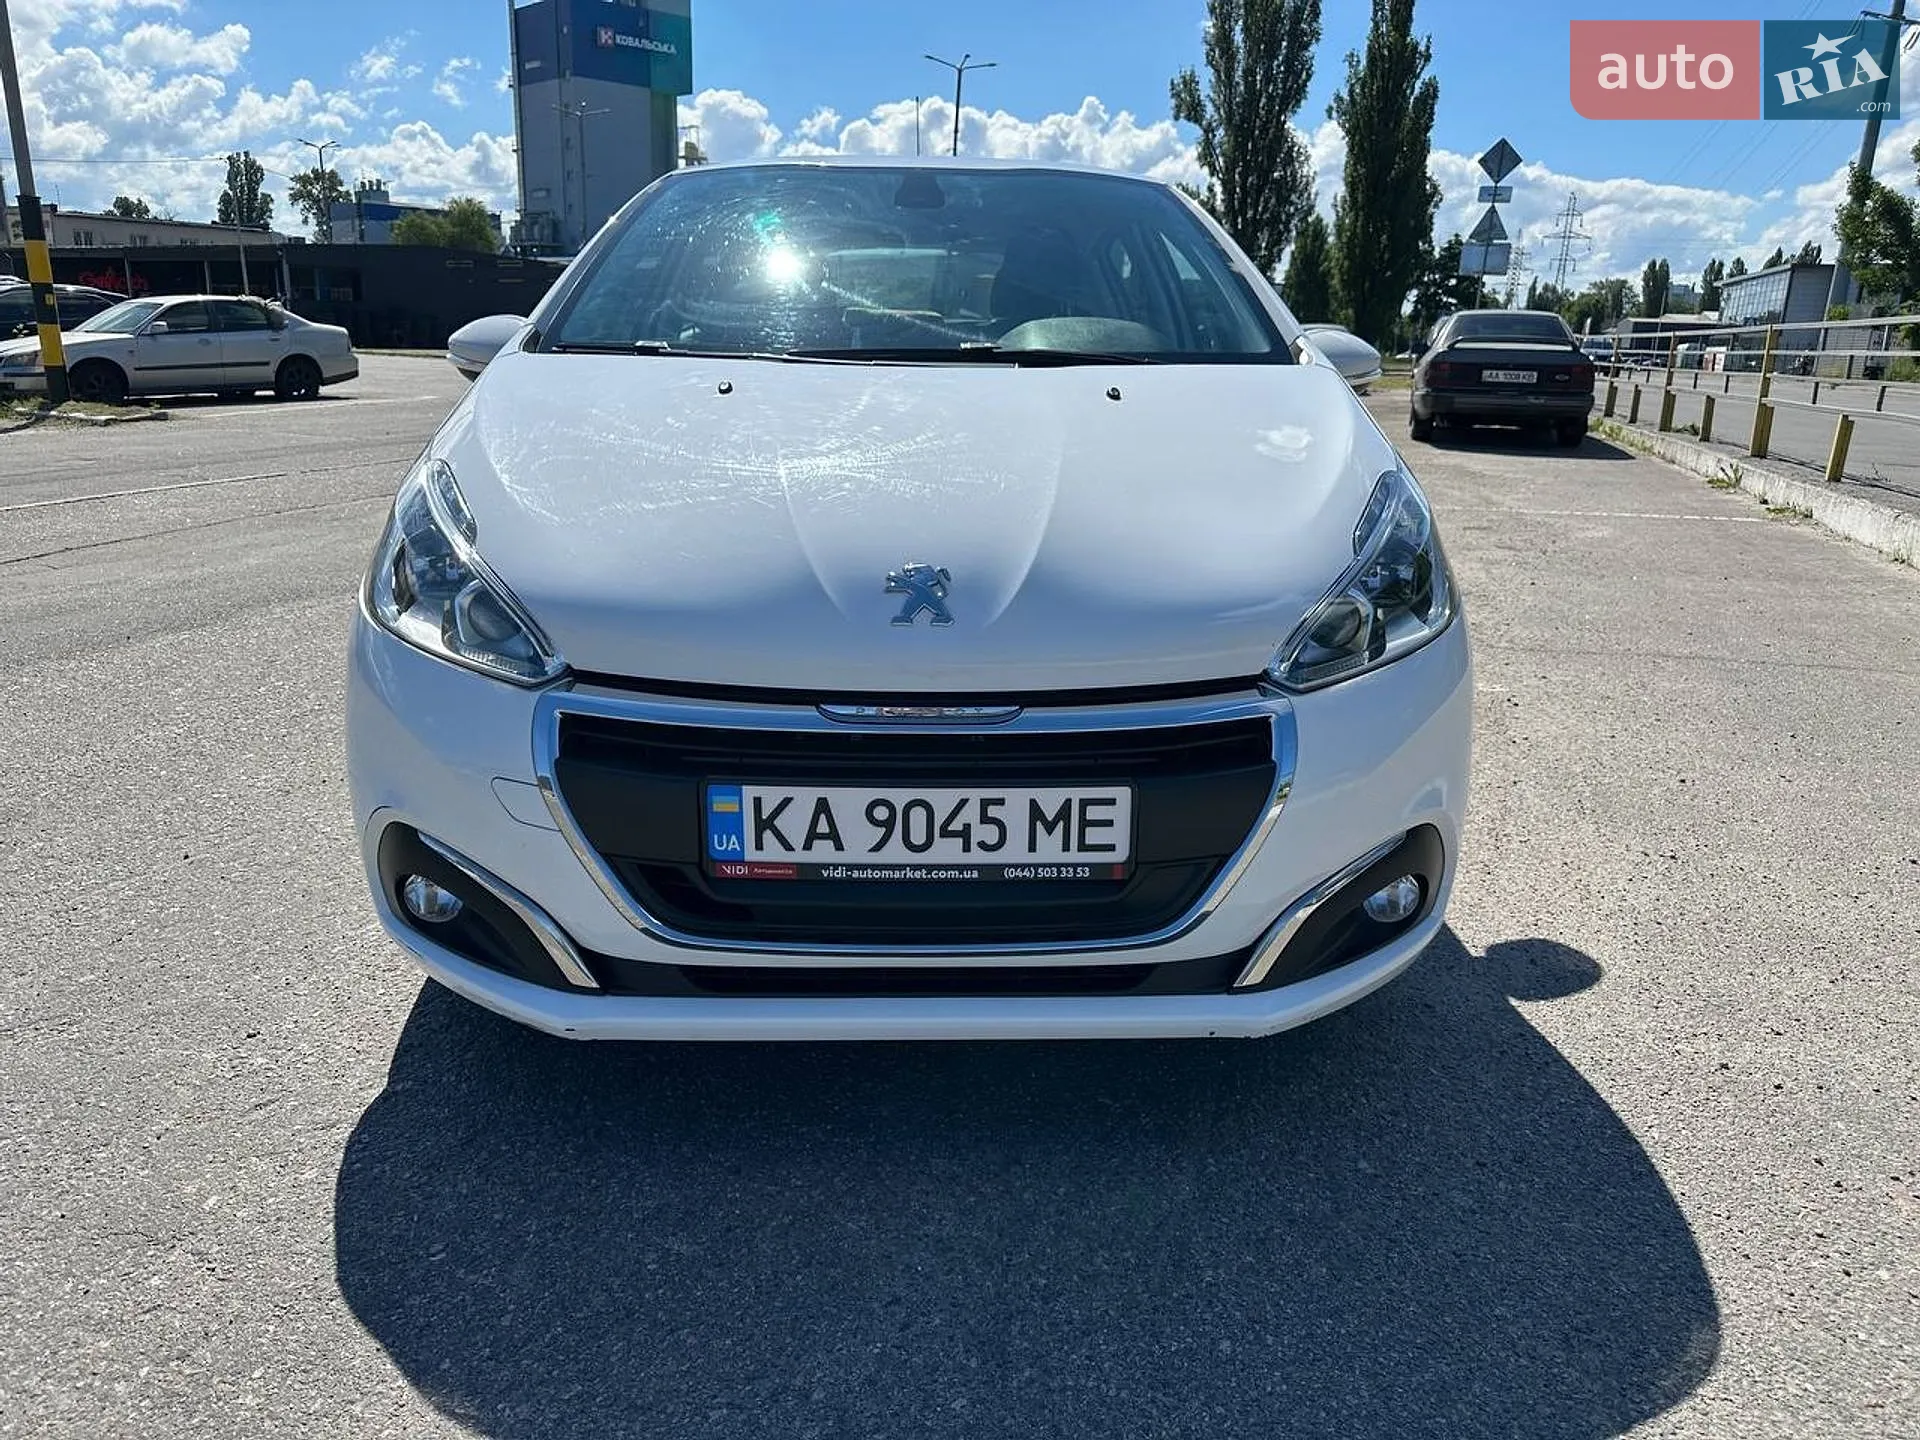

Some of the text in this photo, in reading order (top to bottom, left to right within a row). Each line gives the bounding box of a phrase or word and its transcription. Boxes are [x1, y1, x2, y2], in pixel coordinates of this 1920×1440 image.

[752, 796, 1117, 853] KA 9045 ME
[713, 833, 741, 851] UA
[721, 865, 748, 875] VIDI
[820, 865, 1090, 880] vidi-automarket.com.ua (044) 503 33 53
